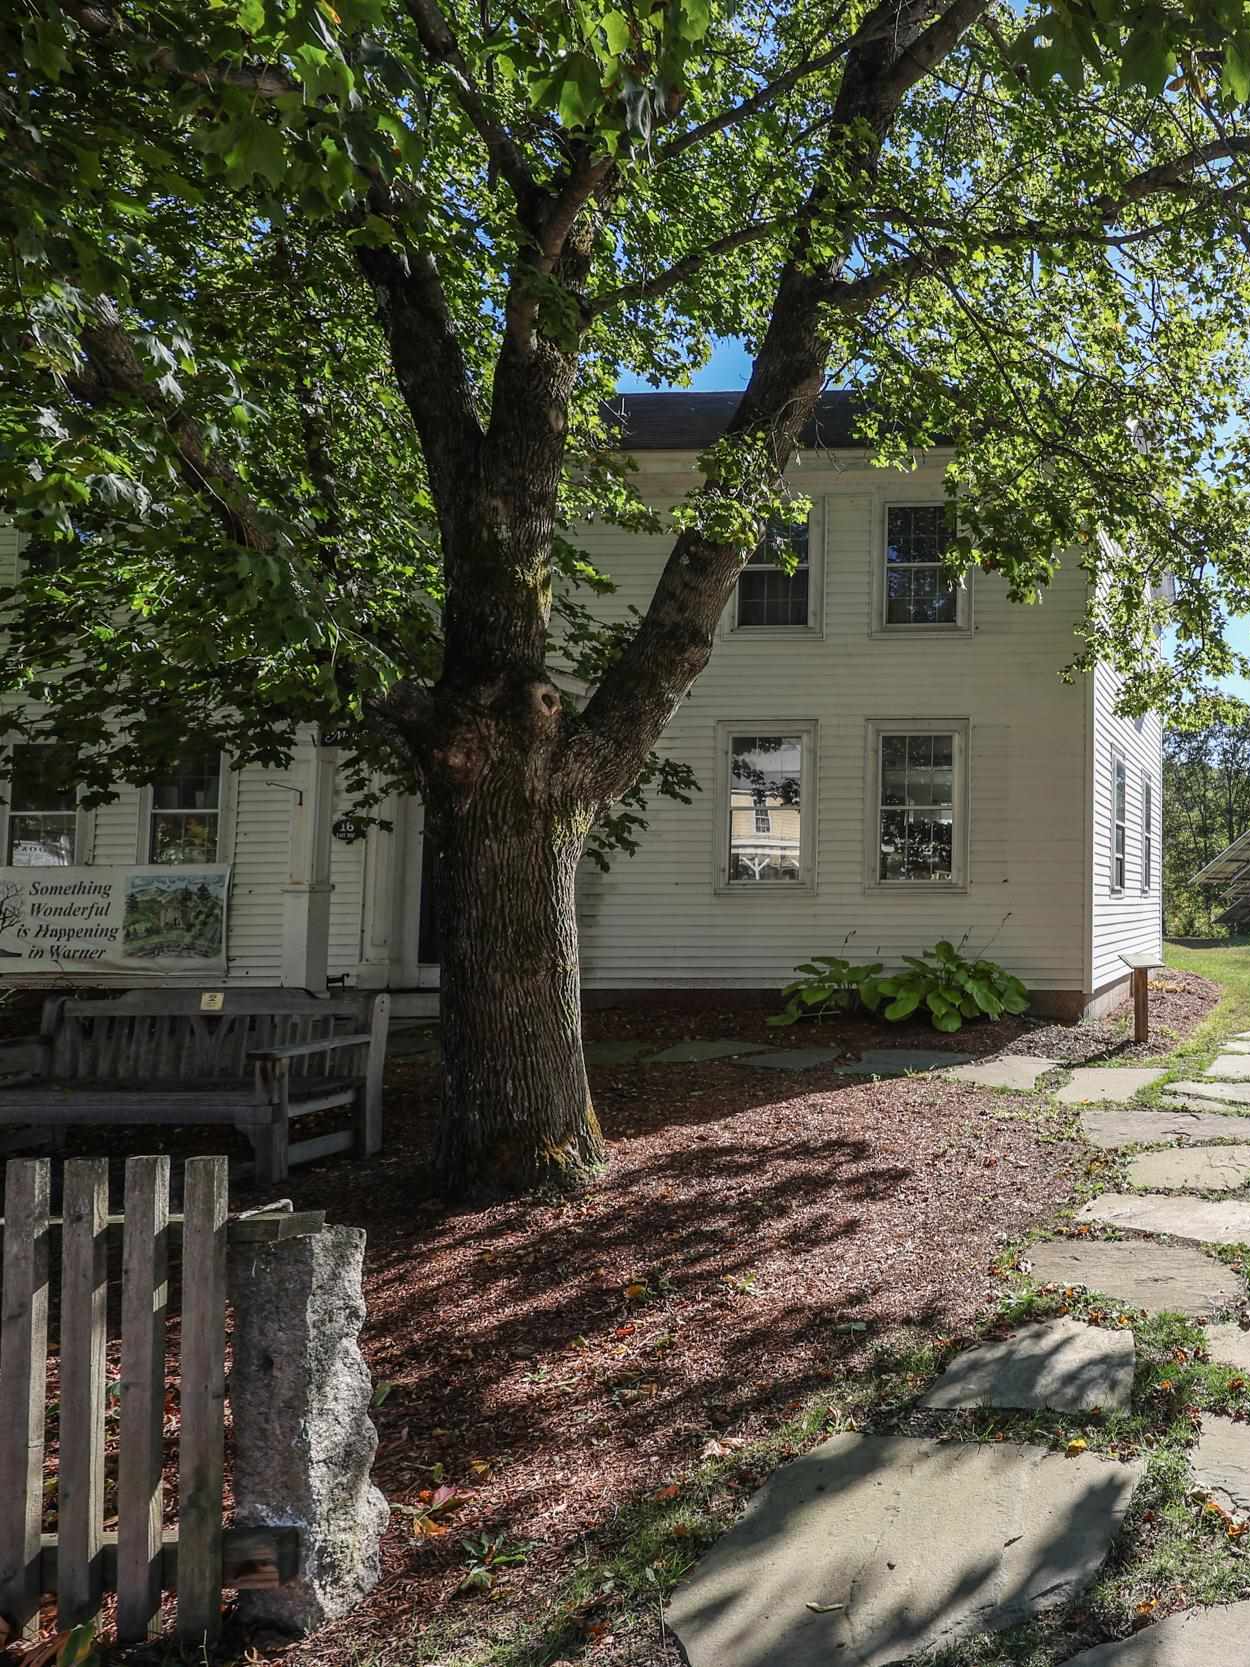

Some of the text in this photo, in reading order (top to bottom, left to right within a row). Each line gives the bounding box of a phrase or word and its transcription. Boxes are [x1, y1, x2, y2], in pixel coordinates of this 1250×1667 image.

[28, 881, 112, 899] Something
[30, 902, 111, 920] Wonderful
[16, 923, 120, 942] is Happening
[28, 944, 107, 960] in Warner
